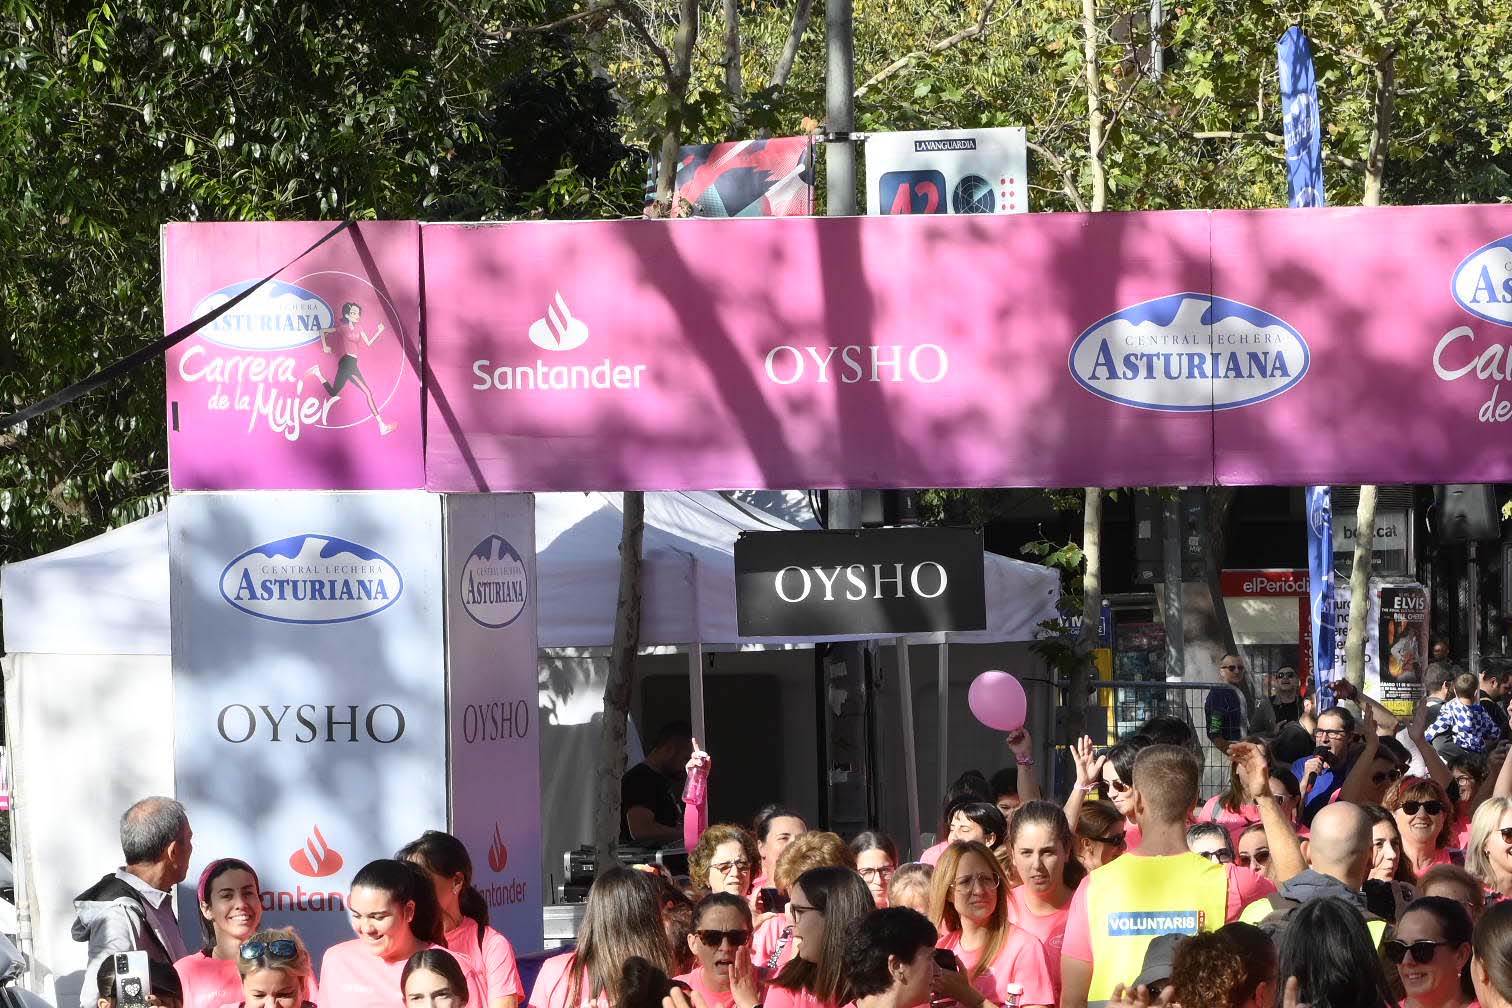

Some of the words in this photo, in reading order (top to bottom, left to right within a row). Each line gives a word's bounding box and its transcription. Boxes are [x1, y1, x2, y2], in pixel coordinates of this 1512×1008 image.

[1125, 334, 1203, 345] CENTRAL
[1208, 333, 1285, 344] LECHERA
[179, 345, 296, 384] Carrera
[472, 358, 647, 391] Santander
[764, 344, 949, 385] OYSHO
[1088, 338, 1290, 382] ASTURIANA
[208, 383, 230, 411] de
[234, 386, 251, 411] la
[248, 379, 341, 441] Mujer
[235, 568, 389, 601] ASTURIANA
[262, 566, 321, 575] CENTRAL
[326, 565, 384, 574] LECHERA
[466, 569, 524, 604] ASTURIANA
[775, 561, 948, 602] OYSHO
[1243, 577, 1309, 592] elPeriódi
[1394, 596, 1424, 609] ELVIS
[217, 704, 406, 744] OYSHO
[464, 700, 529, 744] OYSHO
[262, 885, 348, 912] antan
[1110, 917, 1195, 929] VOLUNTARIS
